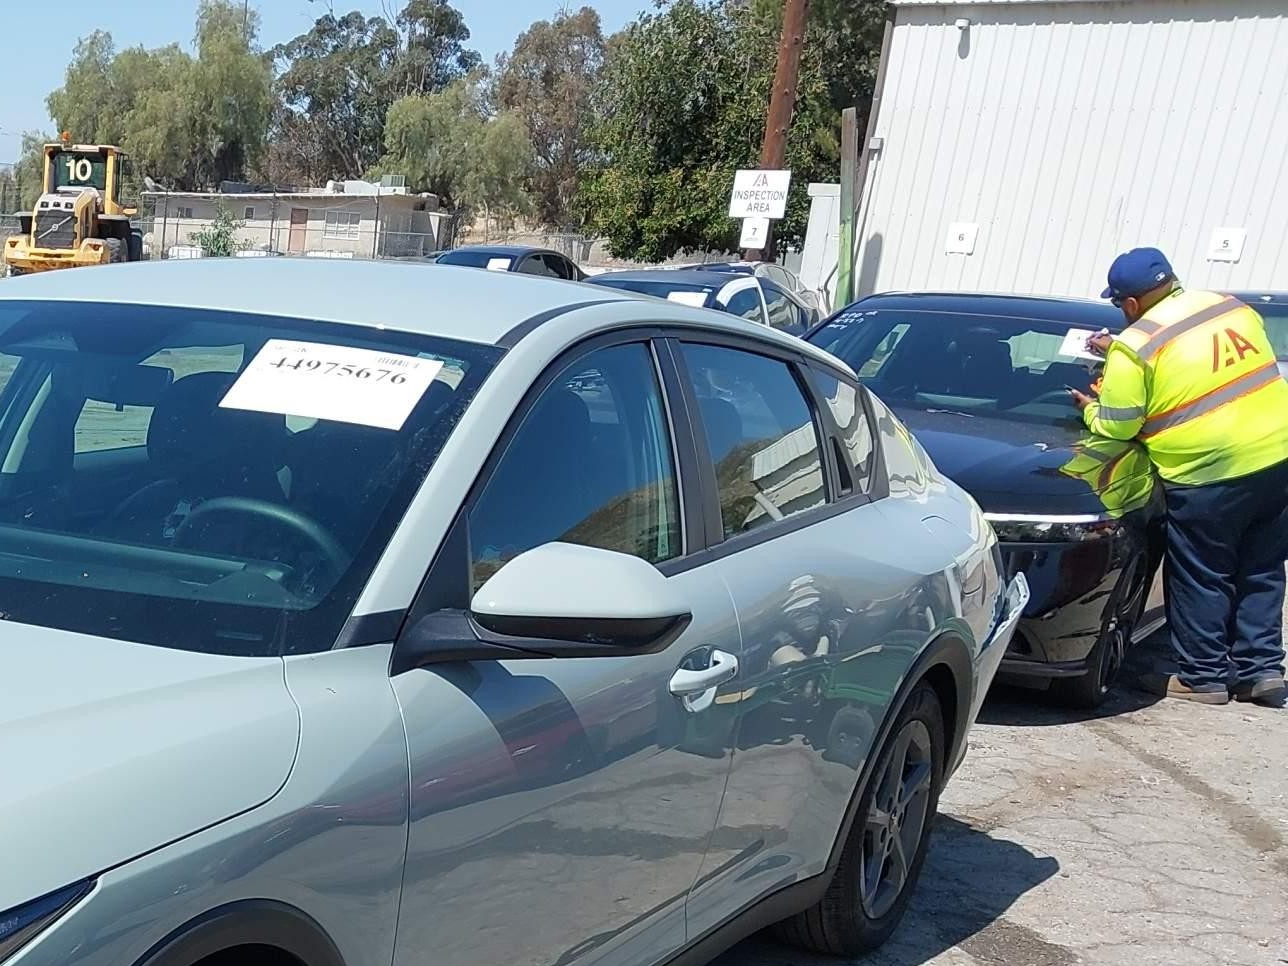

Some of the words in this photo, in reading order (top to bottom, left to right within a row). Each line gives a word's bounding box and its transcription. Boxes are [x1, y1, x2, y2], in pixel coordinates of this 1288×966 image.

[65, 158, 92, 181] 10
[733, 190, 786, 201] INSPECTION
[746, 202, 770, 213] AREA
[751, 228, 757, 236] 7
[958, 233, 965, 242] 6
[1222, 239, 1230, 248] 5
[269, 356, 407, 385] 44975676
